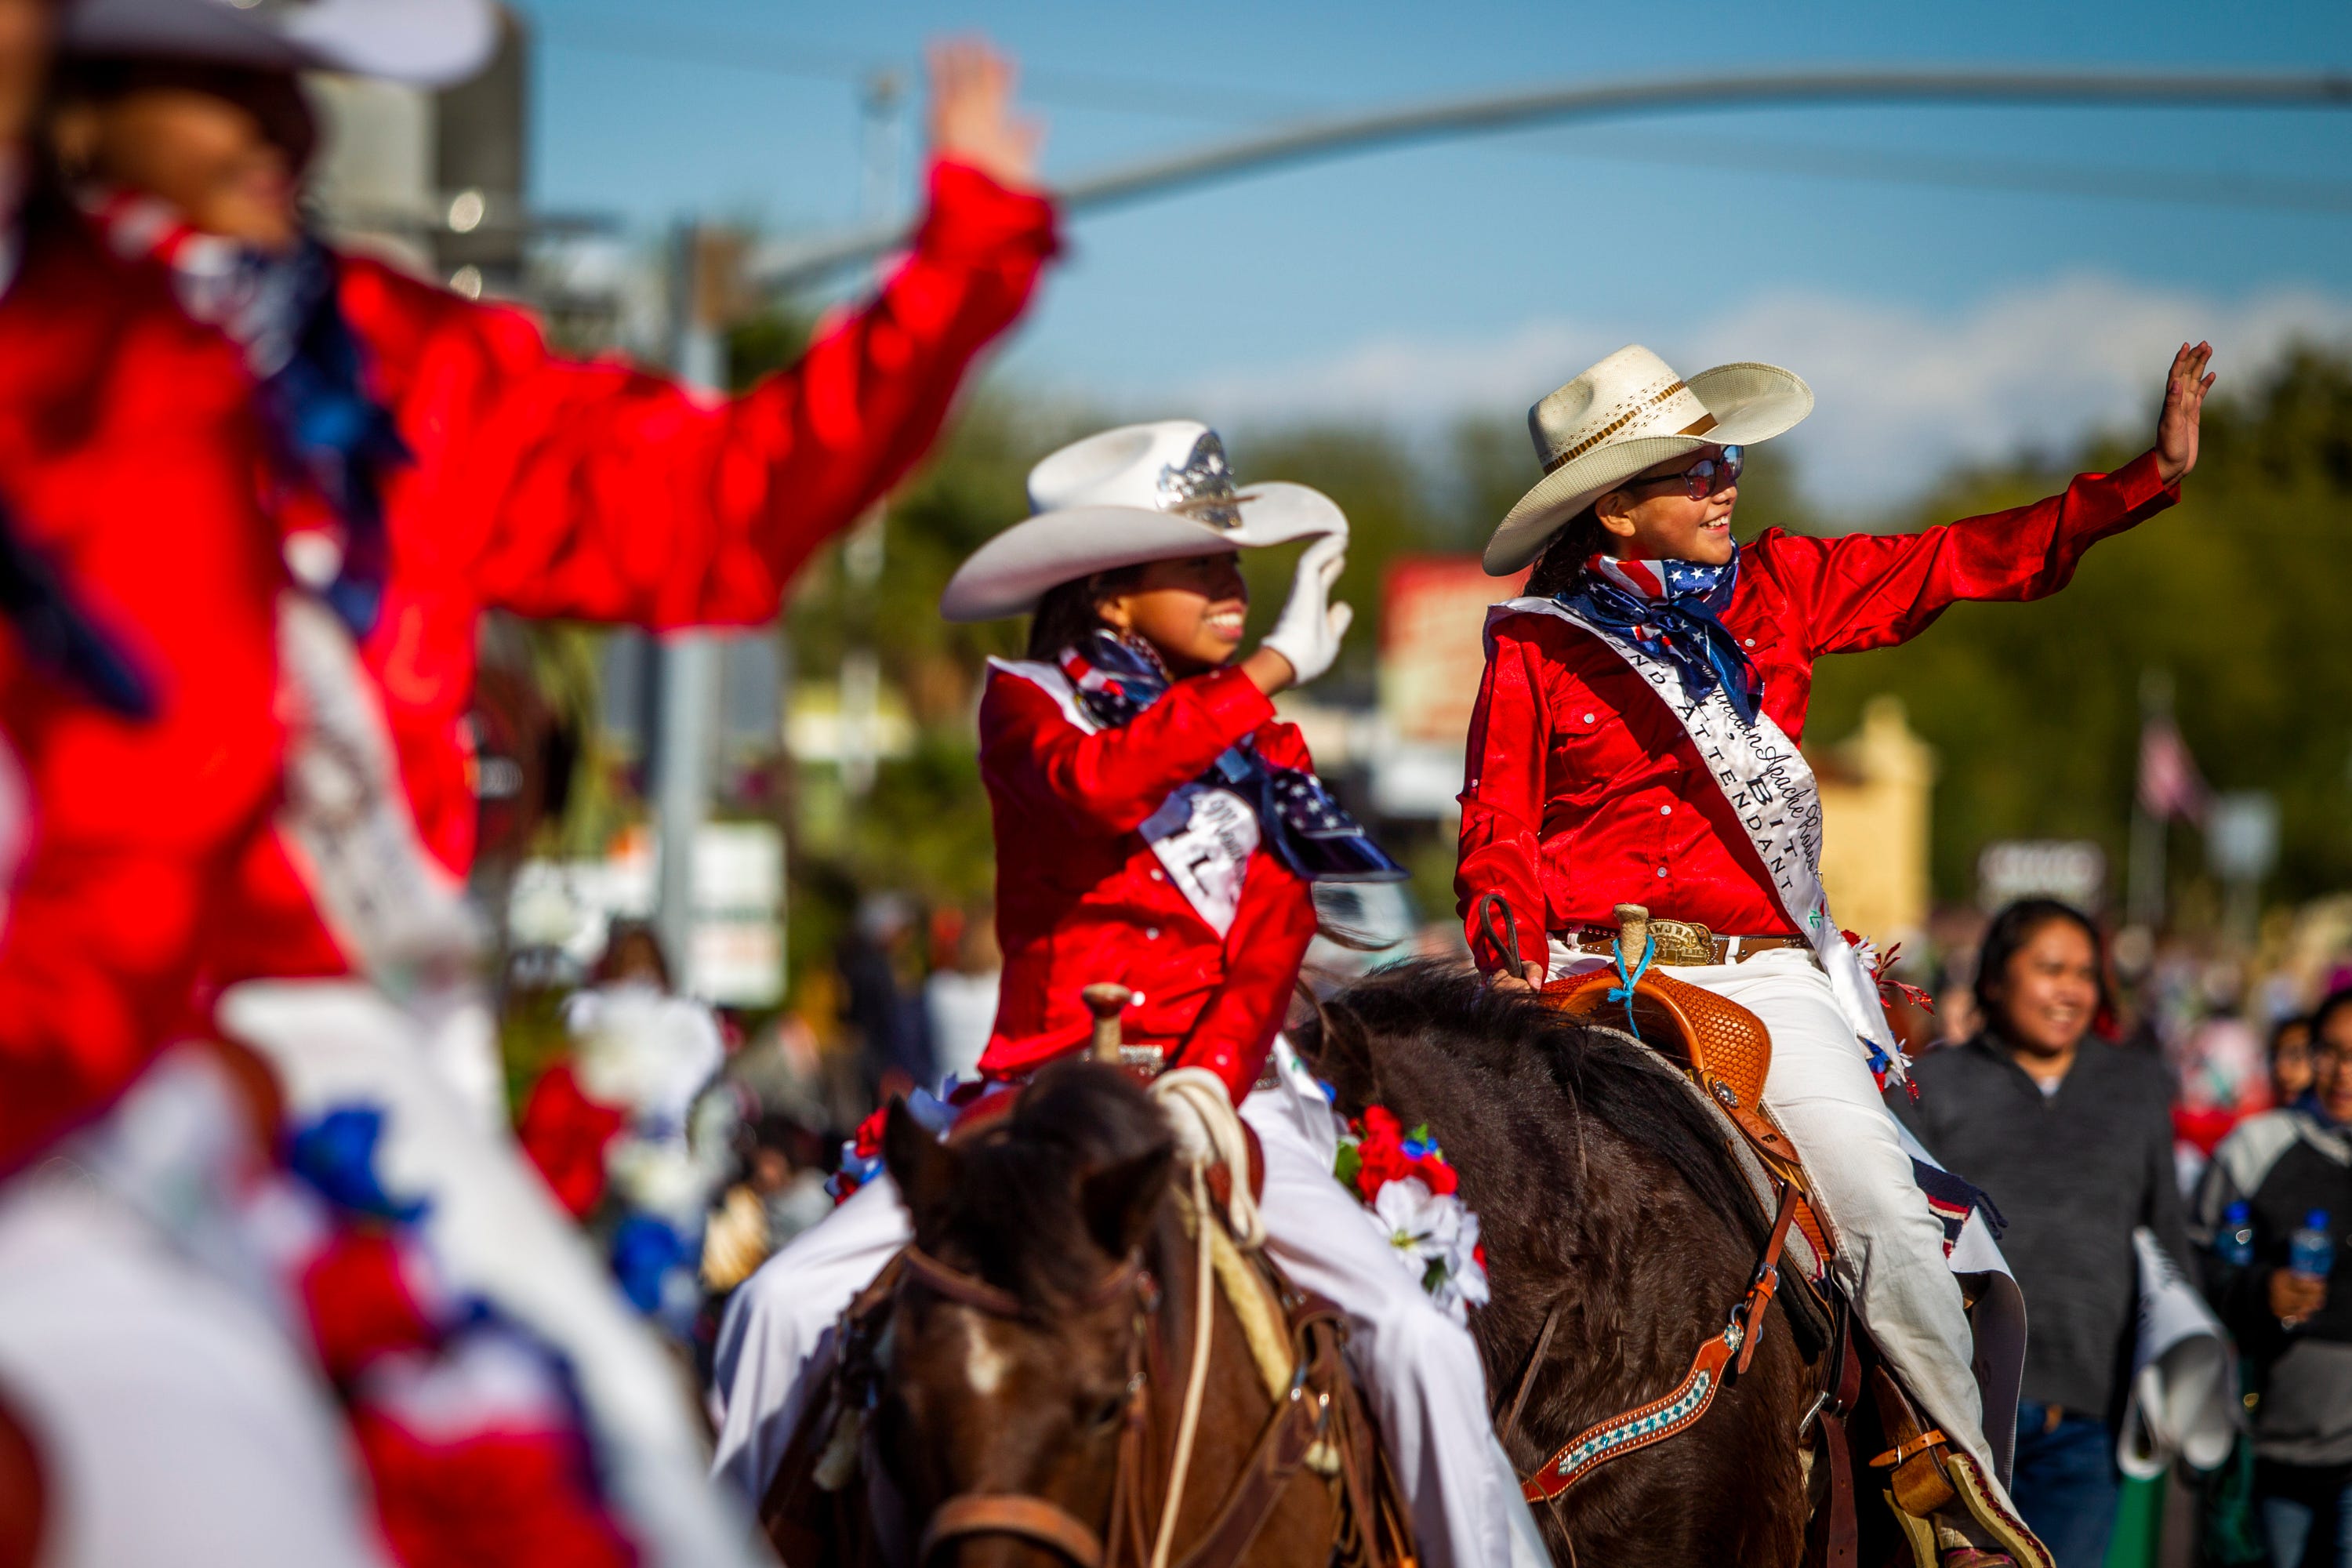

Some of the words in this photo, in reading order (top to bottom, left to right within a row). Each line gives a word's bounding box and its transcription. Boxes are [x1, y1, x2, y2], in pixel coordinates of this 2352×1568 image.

[1607, 640, 1666, 684] 2ND
[1677, 706, 1794, 889] ATTENDANT
[1746, 775, 1798, 857] BIT
[1756, 746, 1813, 818] Apache
[1798, 804, 1820, 872] Rodeo
